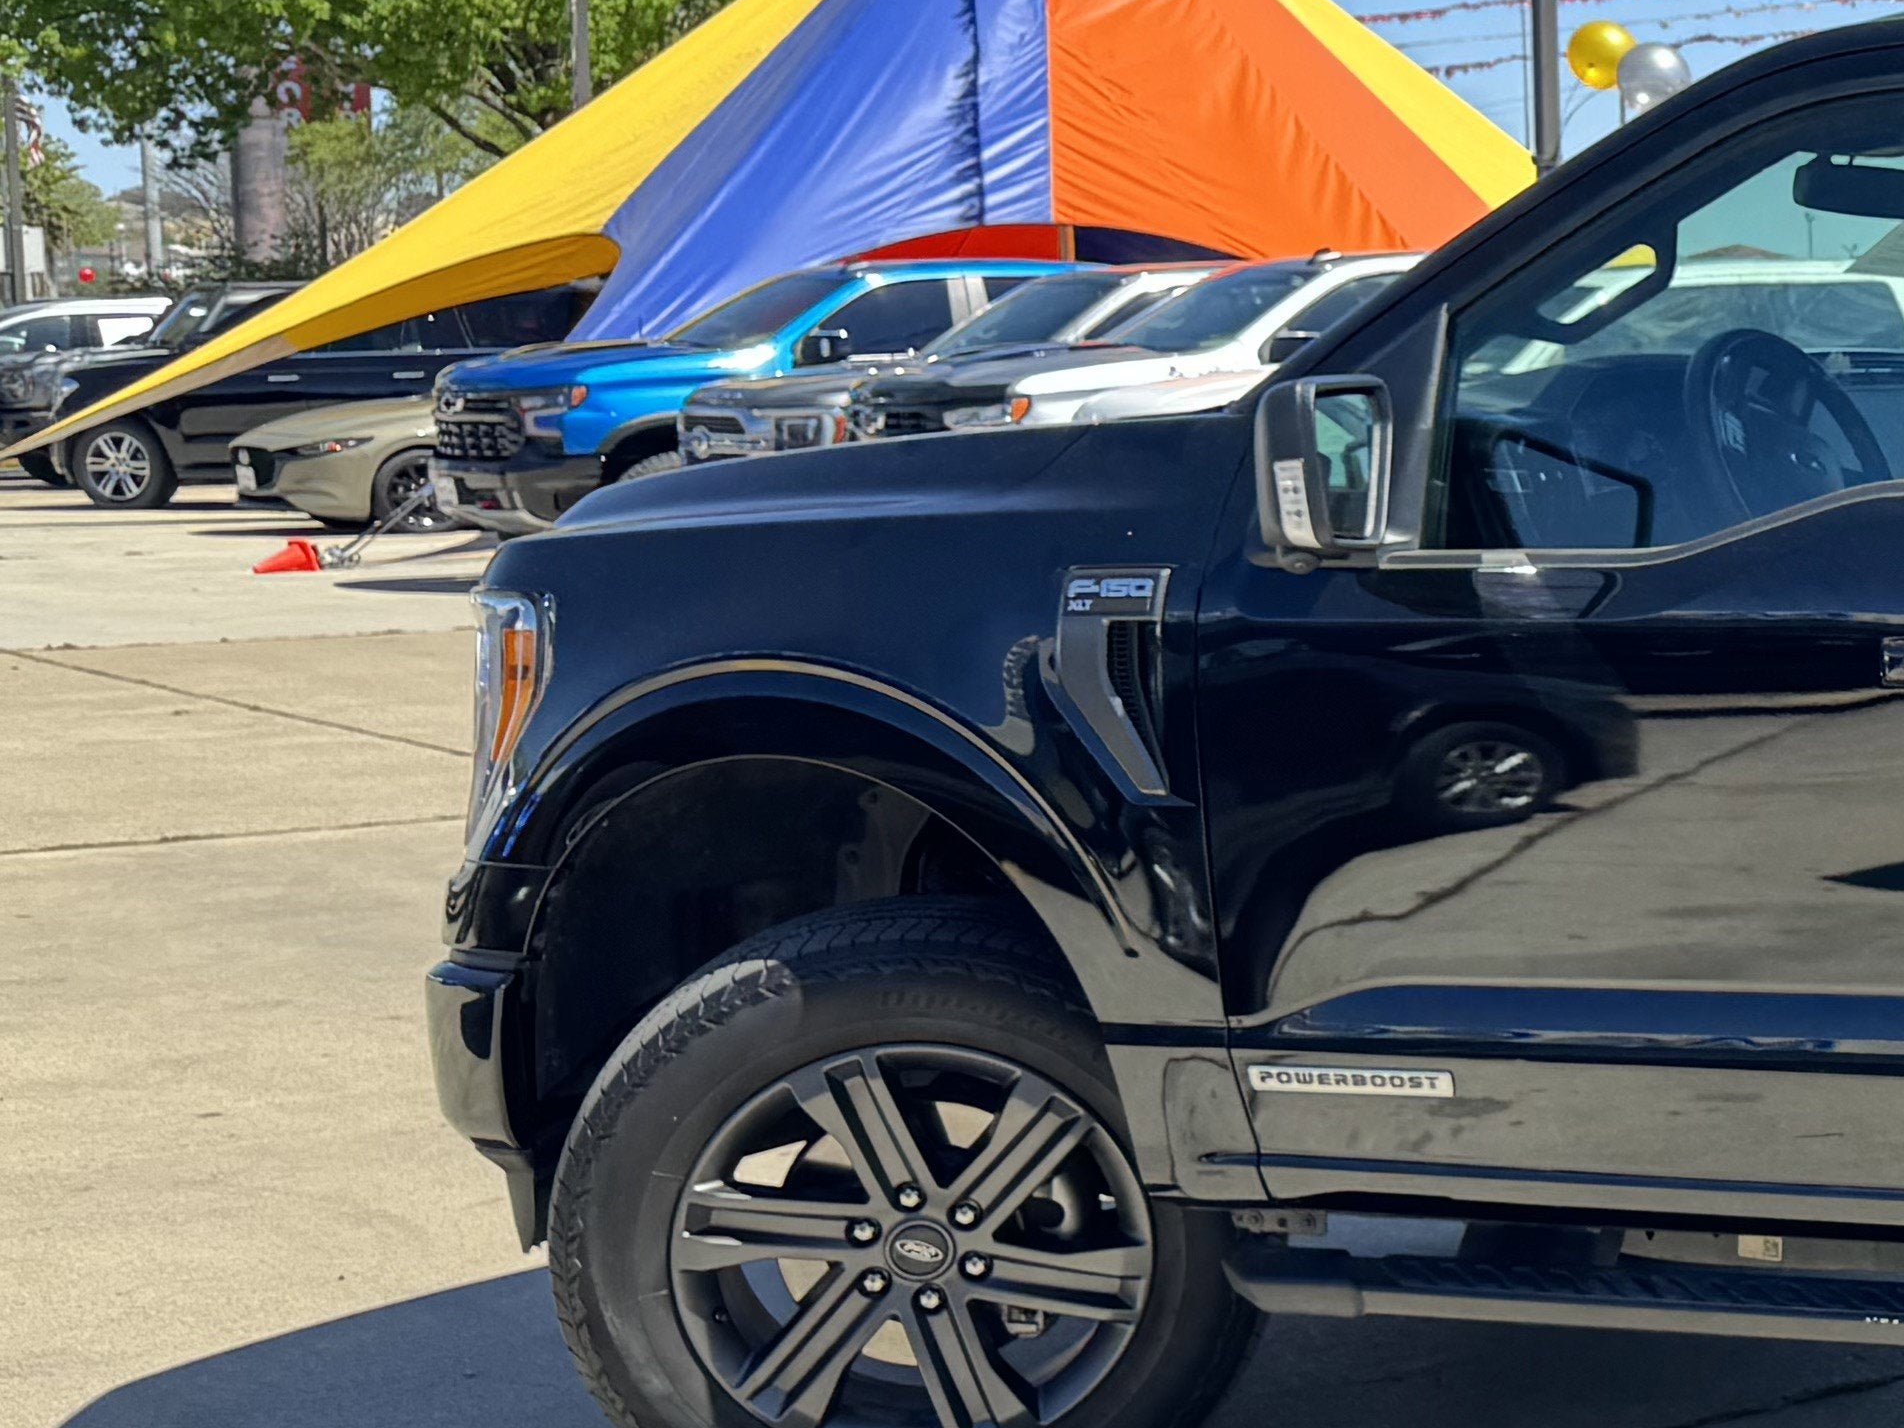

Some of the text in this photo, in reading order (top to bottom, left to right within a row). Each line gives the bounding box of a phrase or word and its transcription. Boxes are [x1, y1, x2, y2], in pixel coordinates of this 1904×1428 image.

[1066, 578, 1155, 598] F-150
[1066, 599, 1094, 612] XLT
[1258, 1070, 1441, 1091] POWERBOOST
